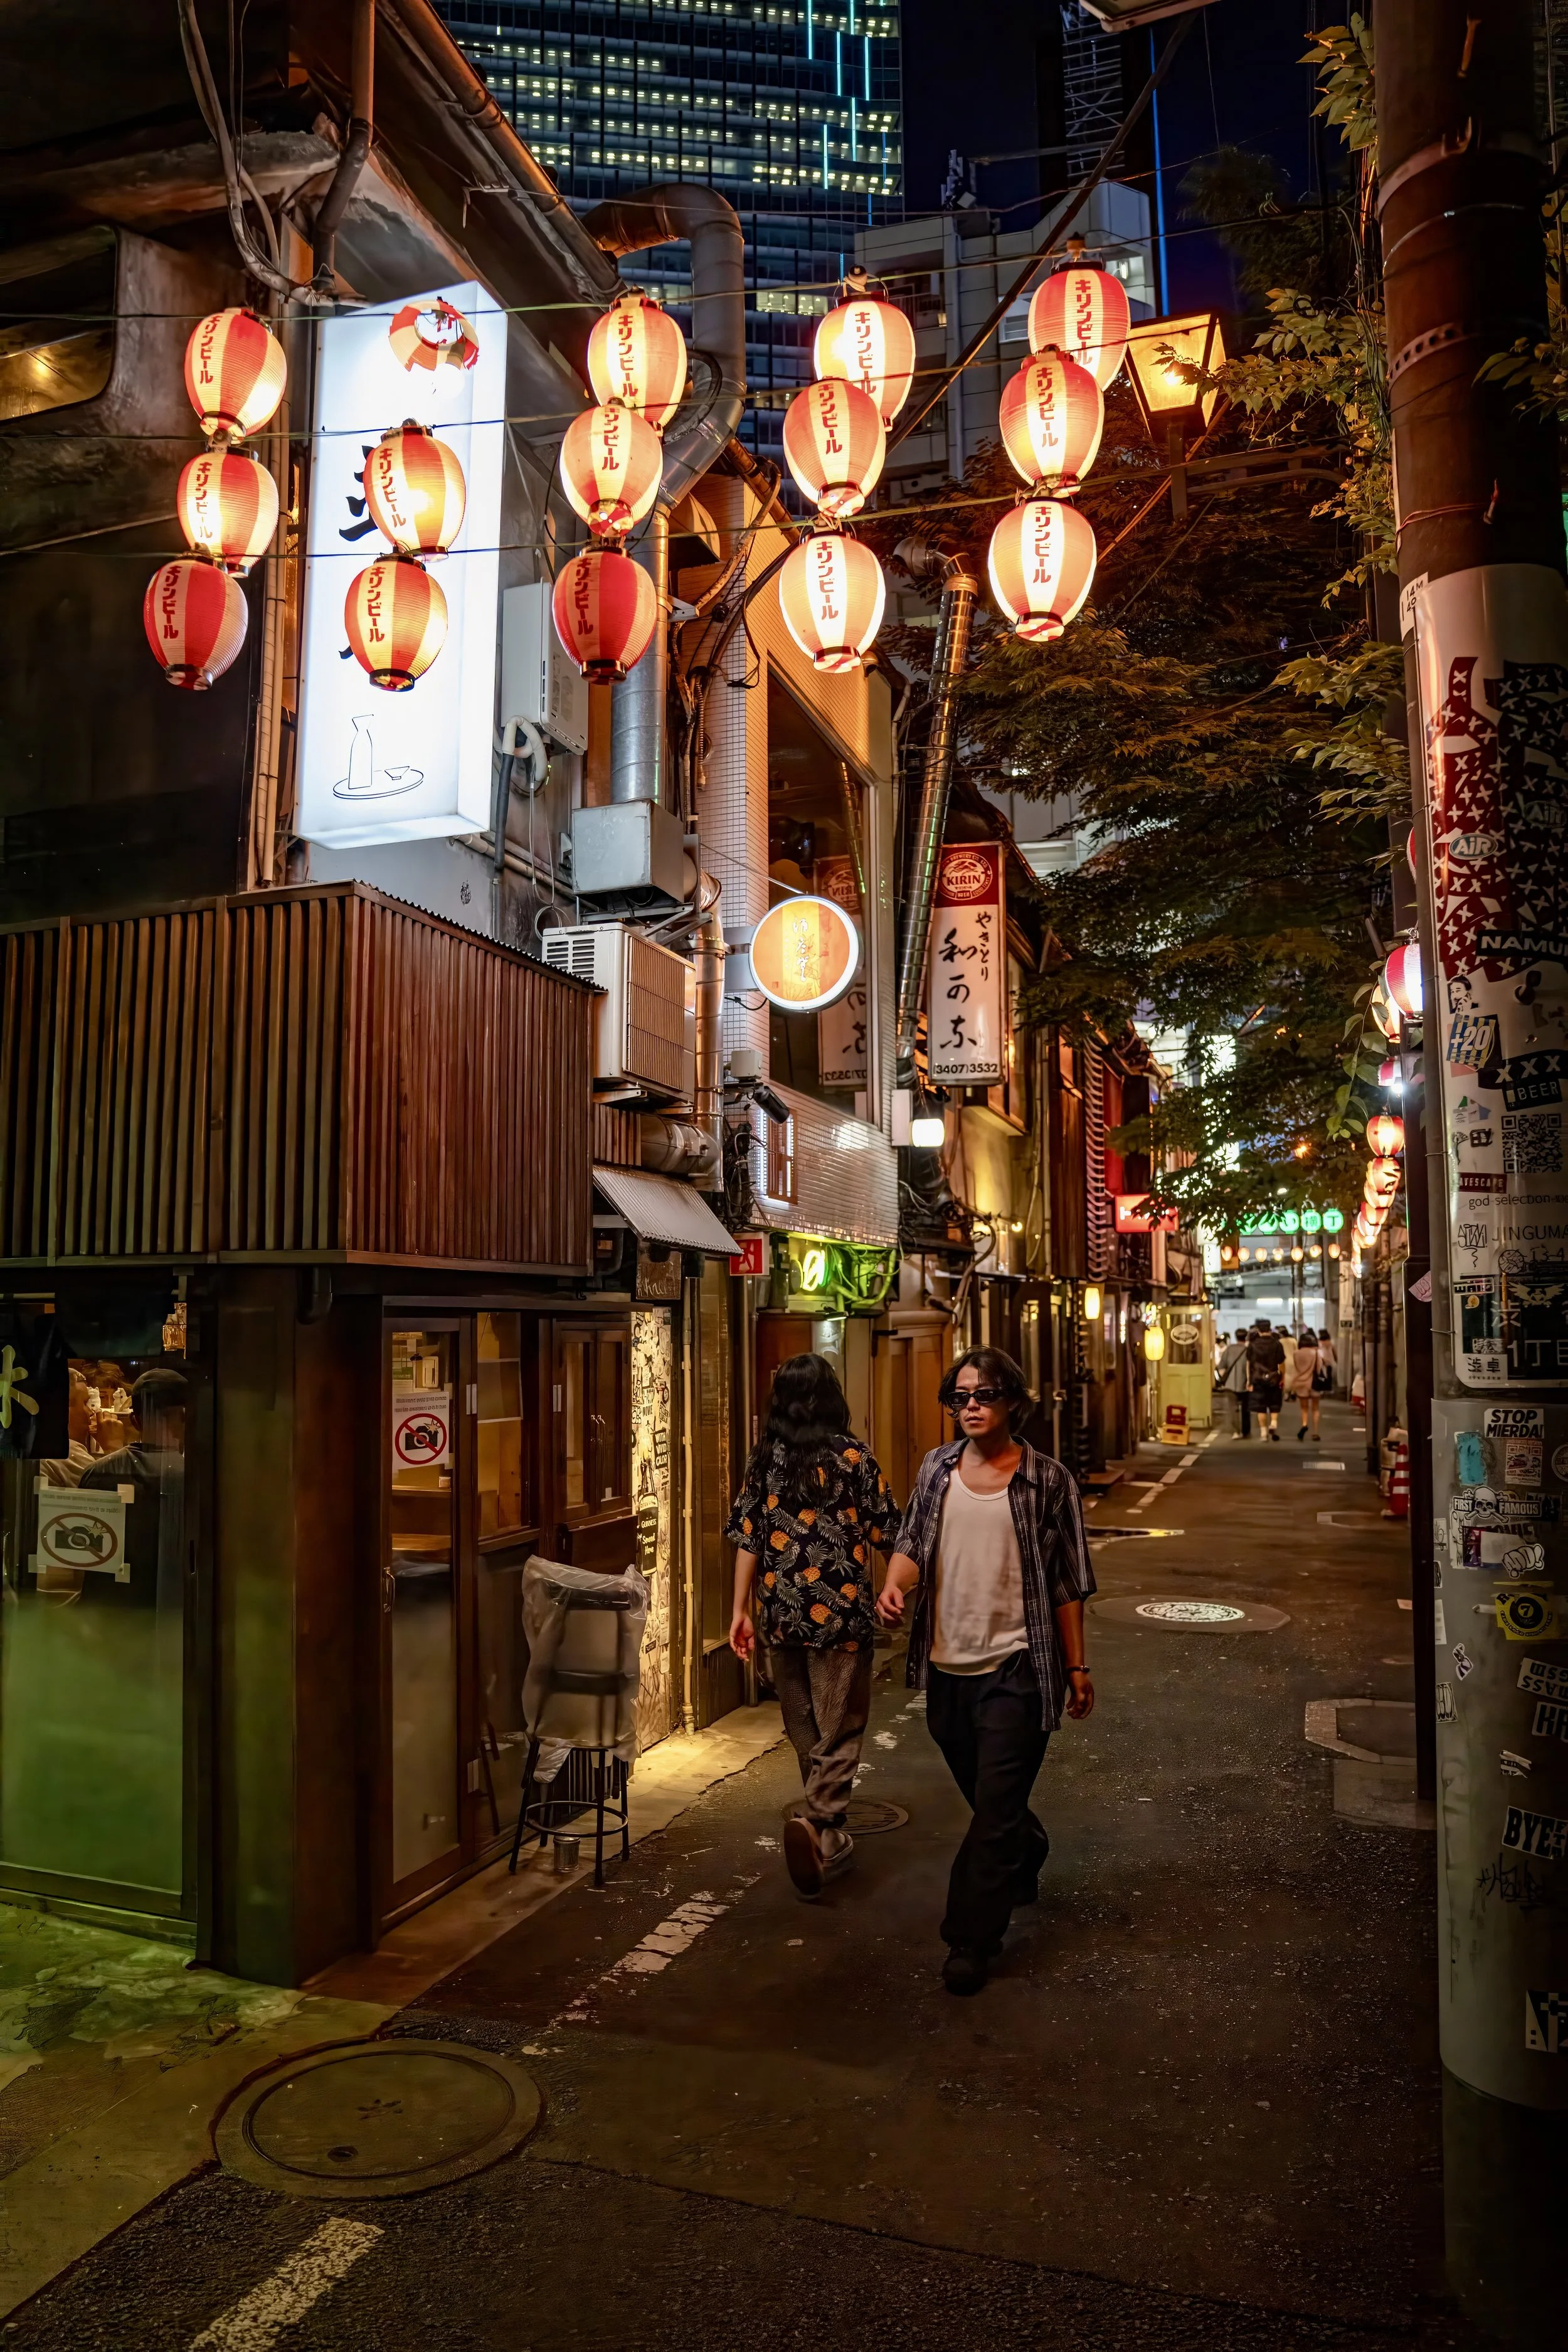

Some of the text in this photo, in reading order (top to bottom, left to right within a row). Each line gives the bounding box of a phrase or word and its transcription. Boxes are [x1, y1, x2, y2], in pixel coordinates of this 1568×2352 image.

[199, 314, 220, 384] キリンビール
[617, 314, 638, 398] キリンビール
[854, 312, 876, 396] キリンビール
[1074, 279, 1093, 366] キリンビール
[818, 381, 843, 456] キリンビール
[1036, 366, 1059, 448] キリンビール
[195, 461, 213, 539] キリンビール
[379, 447, 406, 528] キリンビール
[816, 540, 839, 622] キリンビール
[1032, 506, 1053, 585] キリンビール
[162, 564, 181, 640] キリンビール
[367, 566, 385, 643] キリンビール
[575, 556, 594, 636] キリンビール
[947, 875, 980, 886] KIRIN
[975, 911, 992, 981] やきとり
[1518, 1081, 1559, 1100] BEER
[1486, 1424, 1543, 1438] MIERDA!
[1491, 1409, 1537, 1424] STOP
[1454, 1499, 1539, 1515] FIRST FAMOUS
